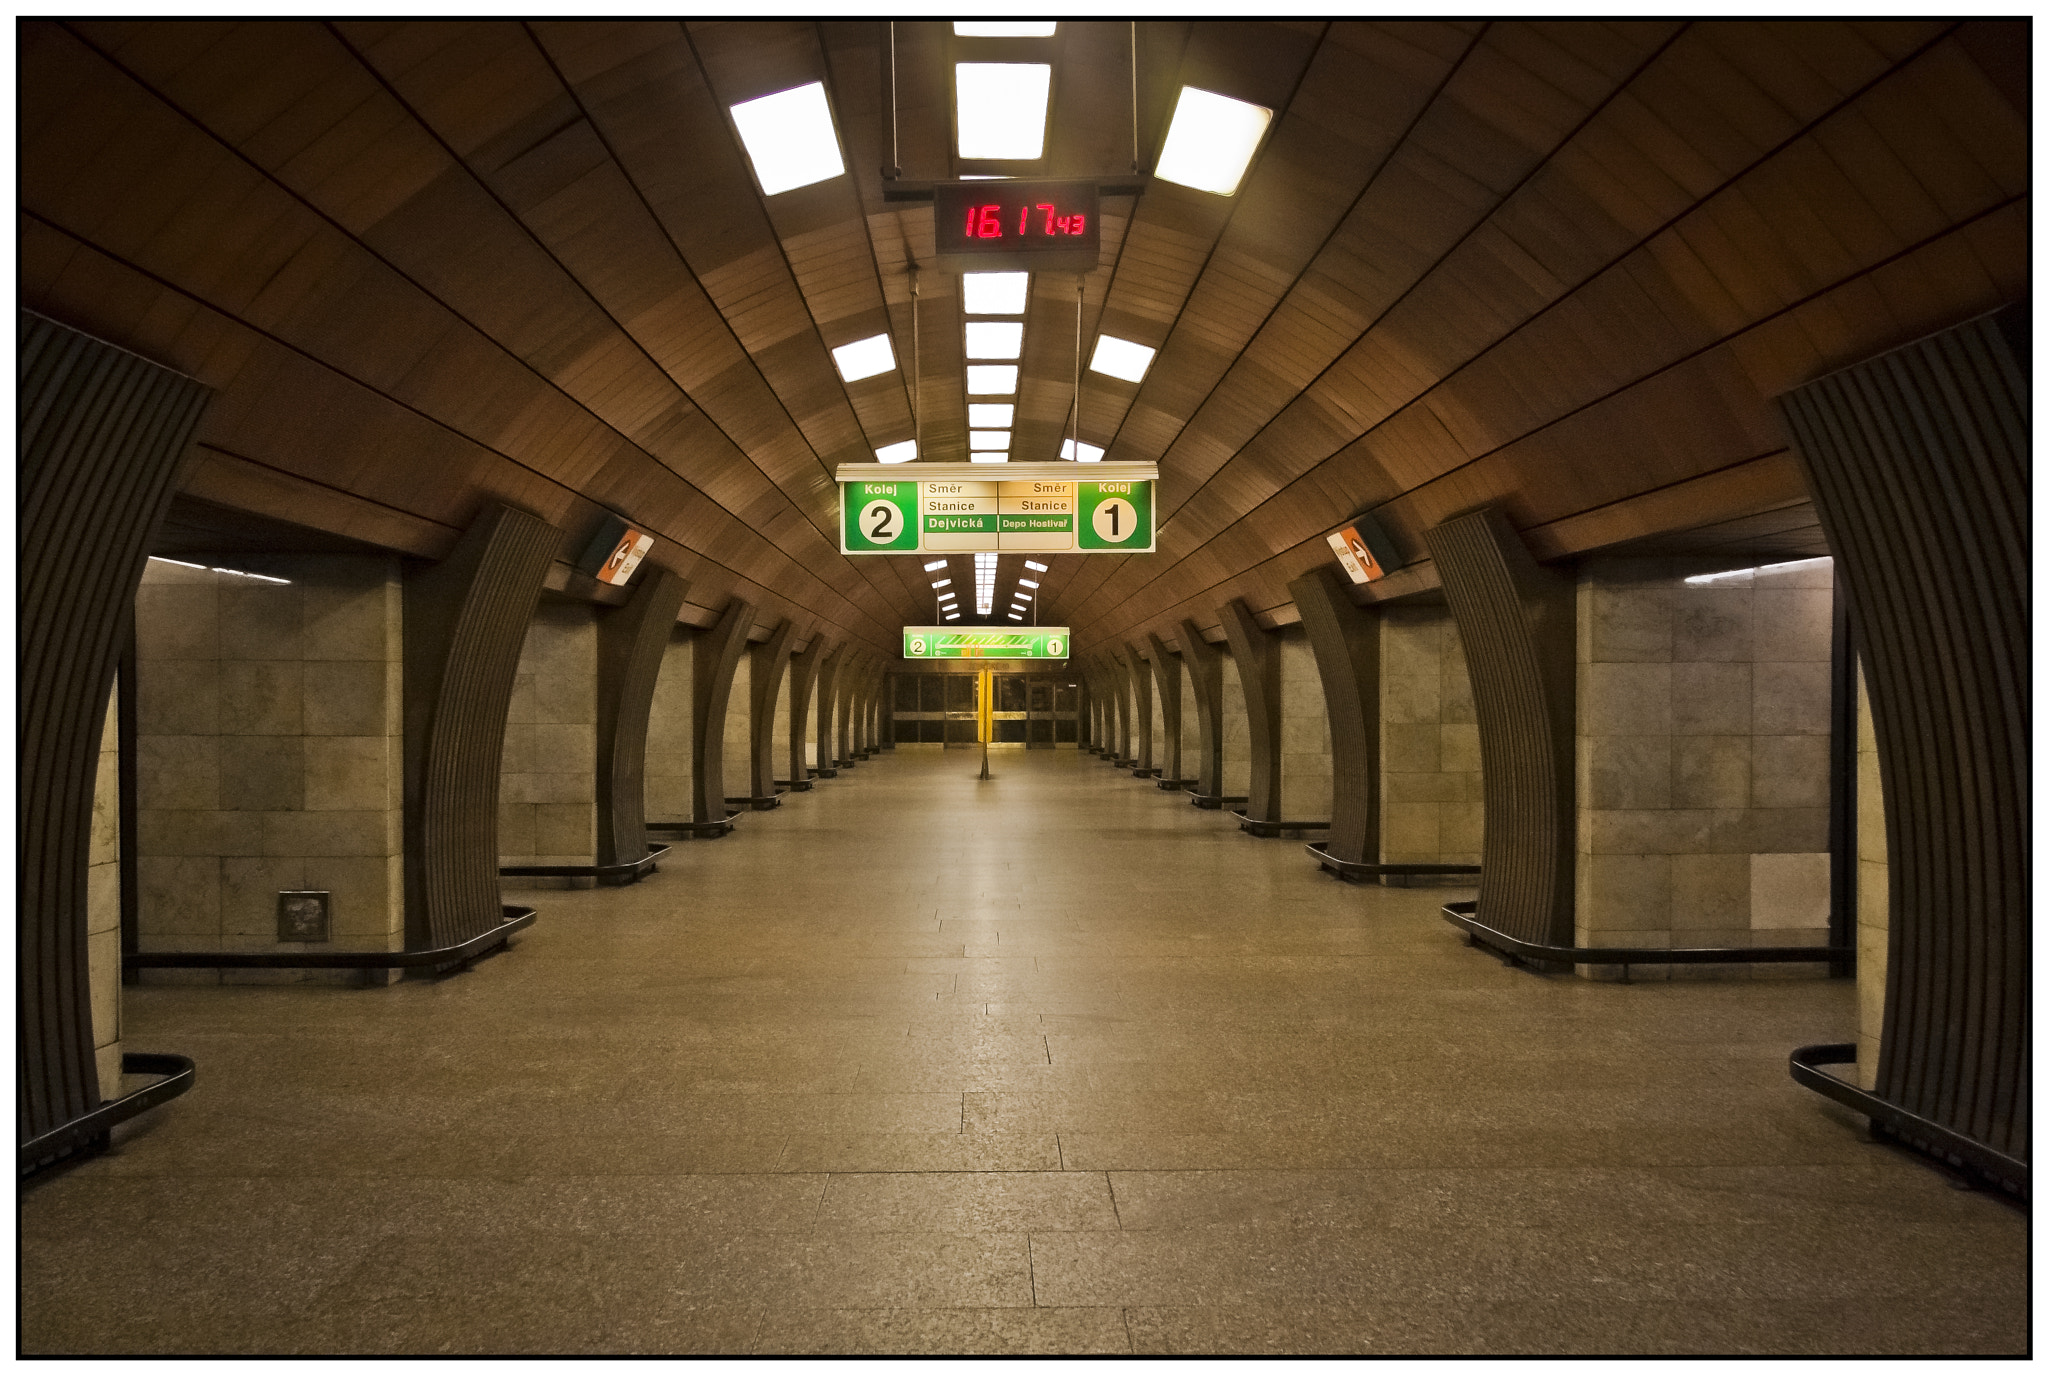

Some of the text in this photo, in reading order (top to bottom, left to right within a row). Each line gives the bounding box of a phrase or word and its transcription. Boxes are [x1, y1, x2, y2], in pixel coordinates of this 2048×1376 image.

[864, 484, 897, 497] Kolej
[929, 484, 963, 494] Směr
[1033, 483, 1067, 493] Směr
[1098, 482, 1131, 495] Kolej
[929, 501, 975, 511] Stanice
[1021, 500, 1068, 510] Stanice
[871, 506, 892, 537] 2
[928, 517, 984, 530] Dejvická
[1002, 519, 1068, 529] Depo Hostivař
[1104, 504, 1119, 536] 1
[914, 641, 922, 653] 2
